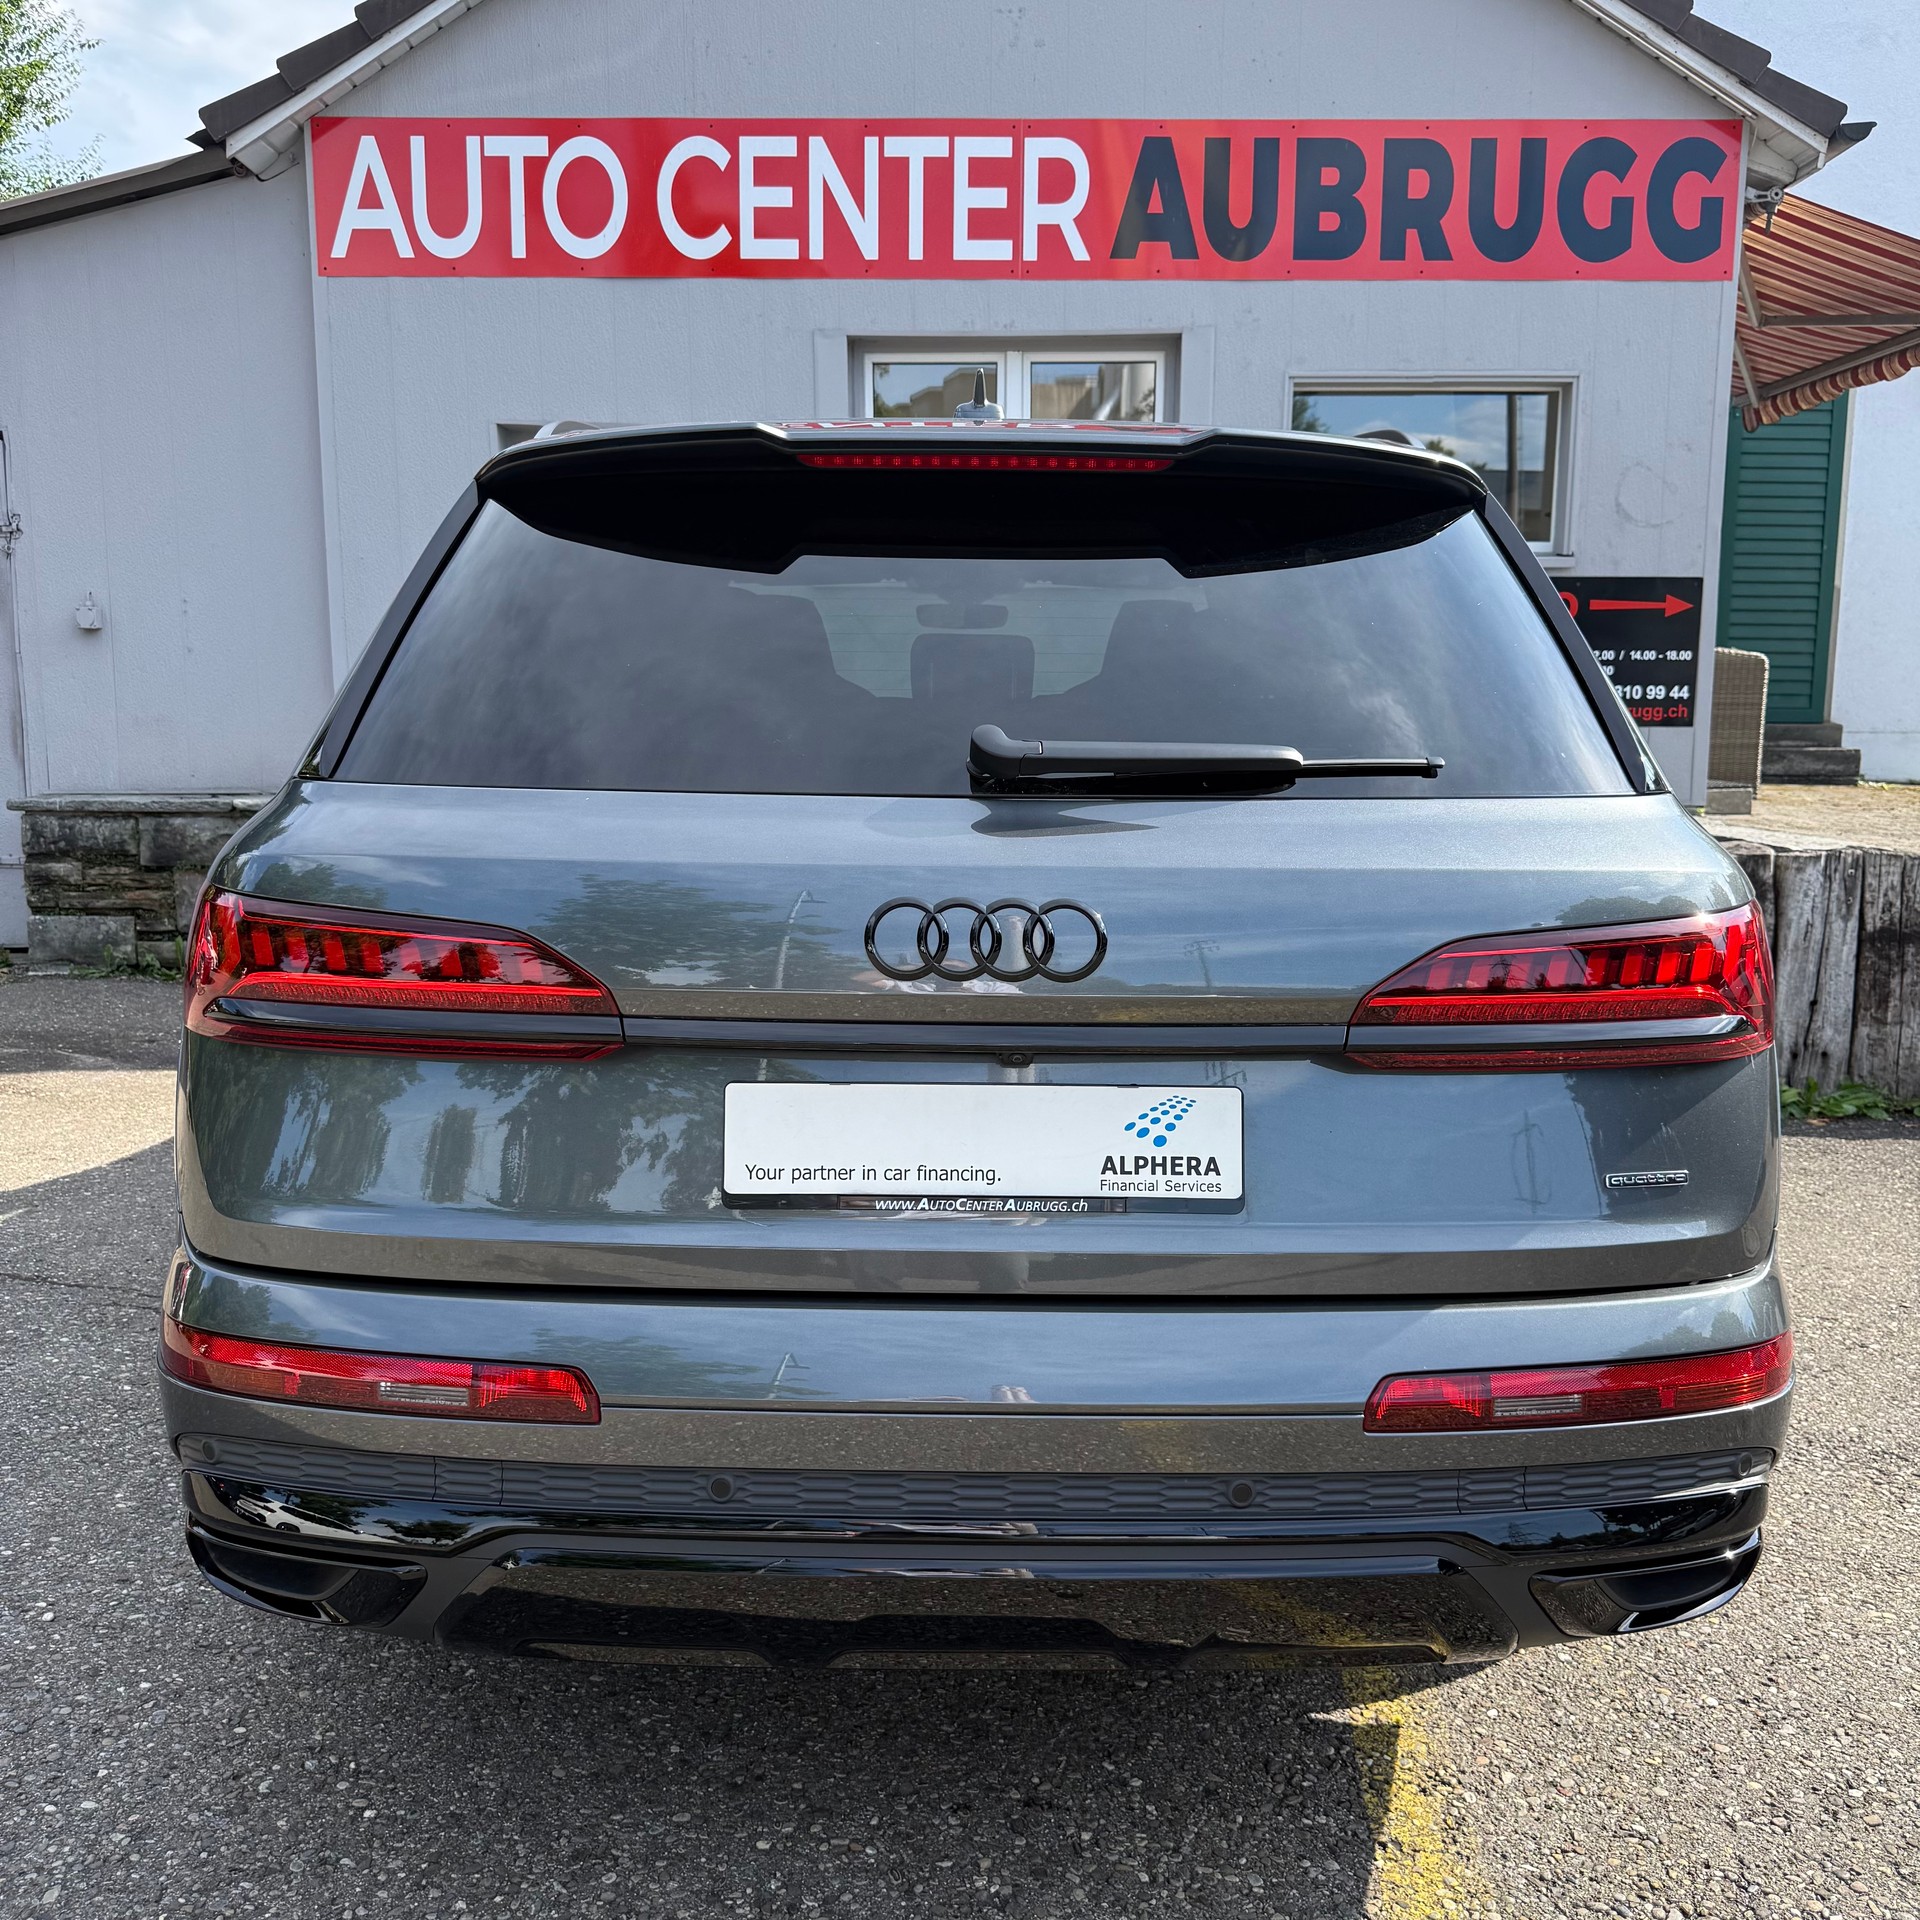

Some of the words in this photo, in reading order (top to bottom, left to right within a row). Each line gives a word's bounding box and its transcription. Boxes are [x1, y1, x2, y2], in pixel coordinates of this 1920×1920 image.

[330, 135, 629, 260] AUTO
[656, 135, 1091, 262] CENTER
[1109, 135, 1728, 263] AUBRUGG
[1629, 650, 1656, 661] 14.00
[1665, 650, 1693, 661] 18.00
[1645, 685, 1666, 700] 99
[1668, 685, 1690, 700] 44
[1100, 1155, 1222, 1176] ALPHERA
[745, 1164, 785, 1181] Your
[791, 1165, 856, 1184] partner
[862, 1165, 877, 1181] in
[883, 1167, 911, 1181] car
[917, 1165, 1002, 1186] financing.
[1610, 1173, 1686, 1186] quattro
[1100, 1179, 1159, 1192] Financial
[1164, 1180, 1222, 1193] Services
